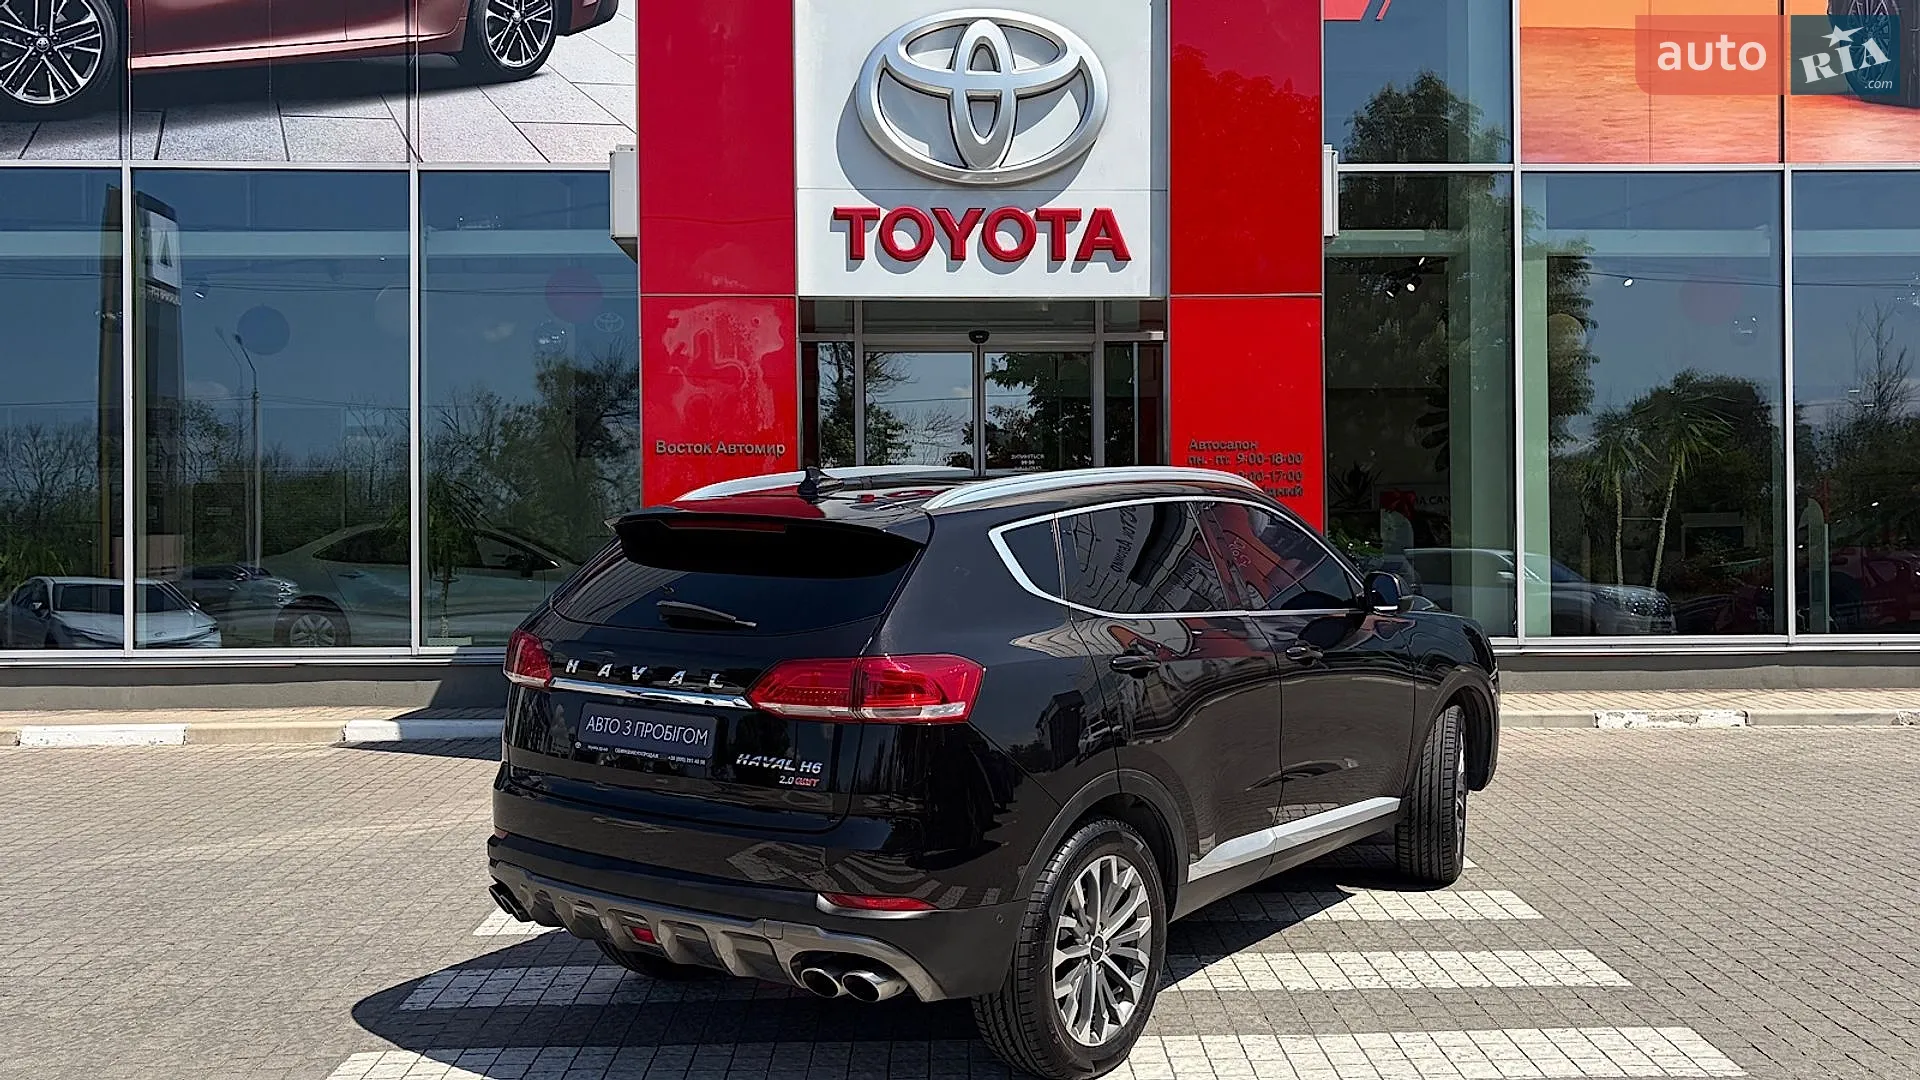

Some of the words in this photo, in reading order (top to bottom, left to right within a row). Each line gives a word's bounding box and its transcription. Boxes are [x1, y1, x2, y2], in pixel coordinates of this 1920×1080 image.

[833, 206, 1131, 262] TOYOTA
[656, 440, 712, 454] Восток
[716, 441, 785, 457] Автомир
[1189, 439, 1258, 451] Автосалон
[565, 658, 724, 689] HAVAL
[586, 716, 620, 734] АВТО
[634, 721, 708, 746] ПРОБІГОМ
[736, 753, 796, 771] HAVAL
[800, 760, 823, 774] H6
